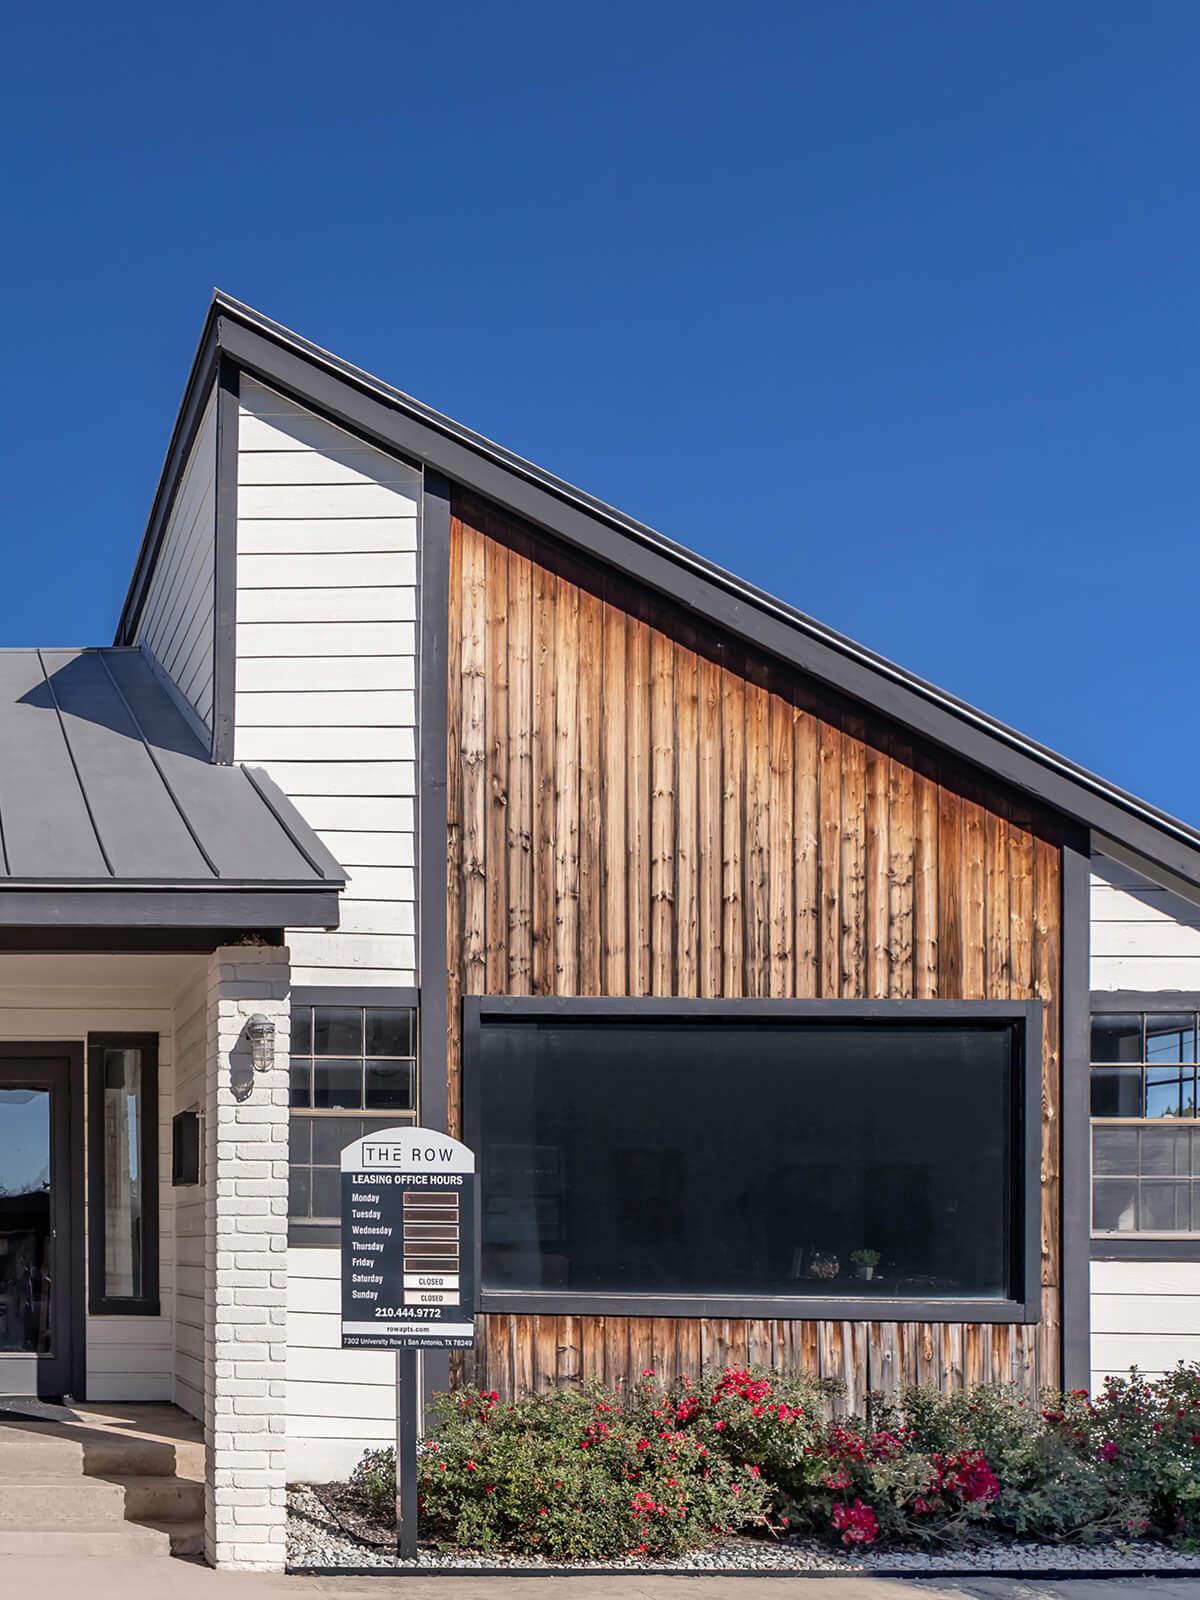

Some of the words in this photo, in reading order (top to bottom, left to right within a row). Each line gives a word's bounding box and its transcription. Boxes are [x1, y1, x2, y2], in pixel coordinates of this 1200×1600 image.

[366, 1148, 401, 1161] THE
[412, 1148, 453, 1162] ROW
[352, 1175, 392, 1184] LEASING
[394, 1175, 428, 1184] OFFICE
[430, 1176, 463, 1185] HOURS
[352, 1193, 379, 1204] Monday
[352, 1209, 381, 1220] Tuesday
[352, 1225, 392, 1236] Wednesday
[352, 1241, 384, 1252] Thursday
[352, 1258, 374, 1268] Friday
[352, 1274, 383, 1285] Saturday
[418, 1278, 443, 1286] CLOSED
[352, 1290, 378, 1301] Sunday
[375, 1307, 441, 1318] 210.444.9772
[360, 1337, 388, 1346] University
[407, 1338, 420, 1346] San
